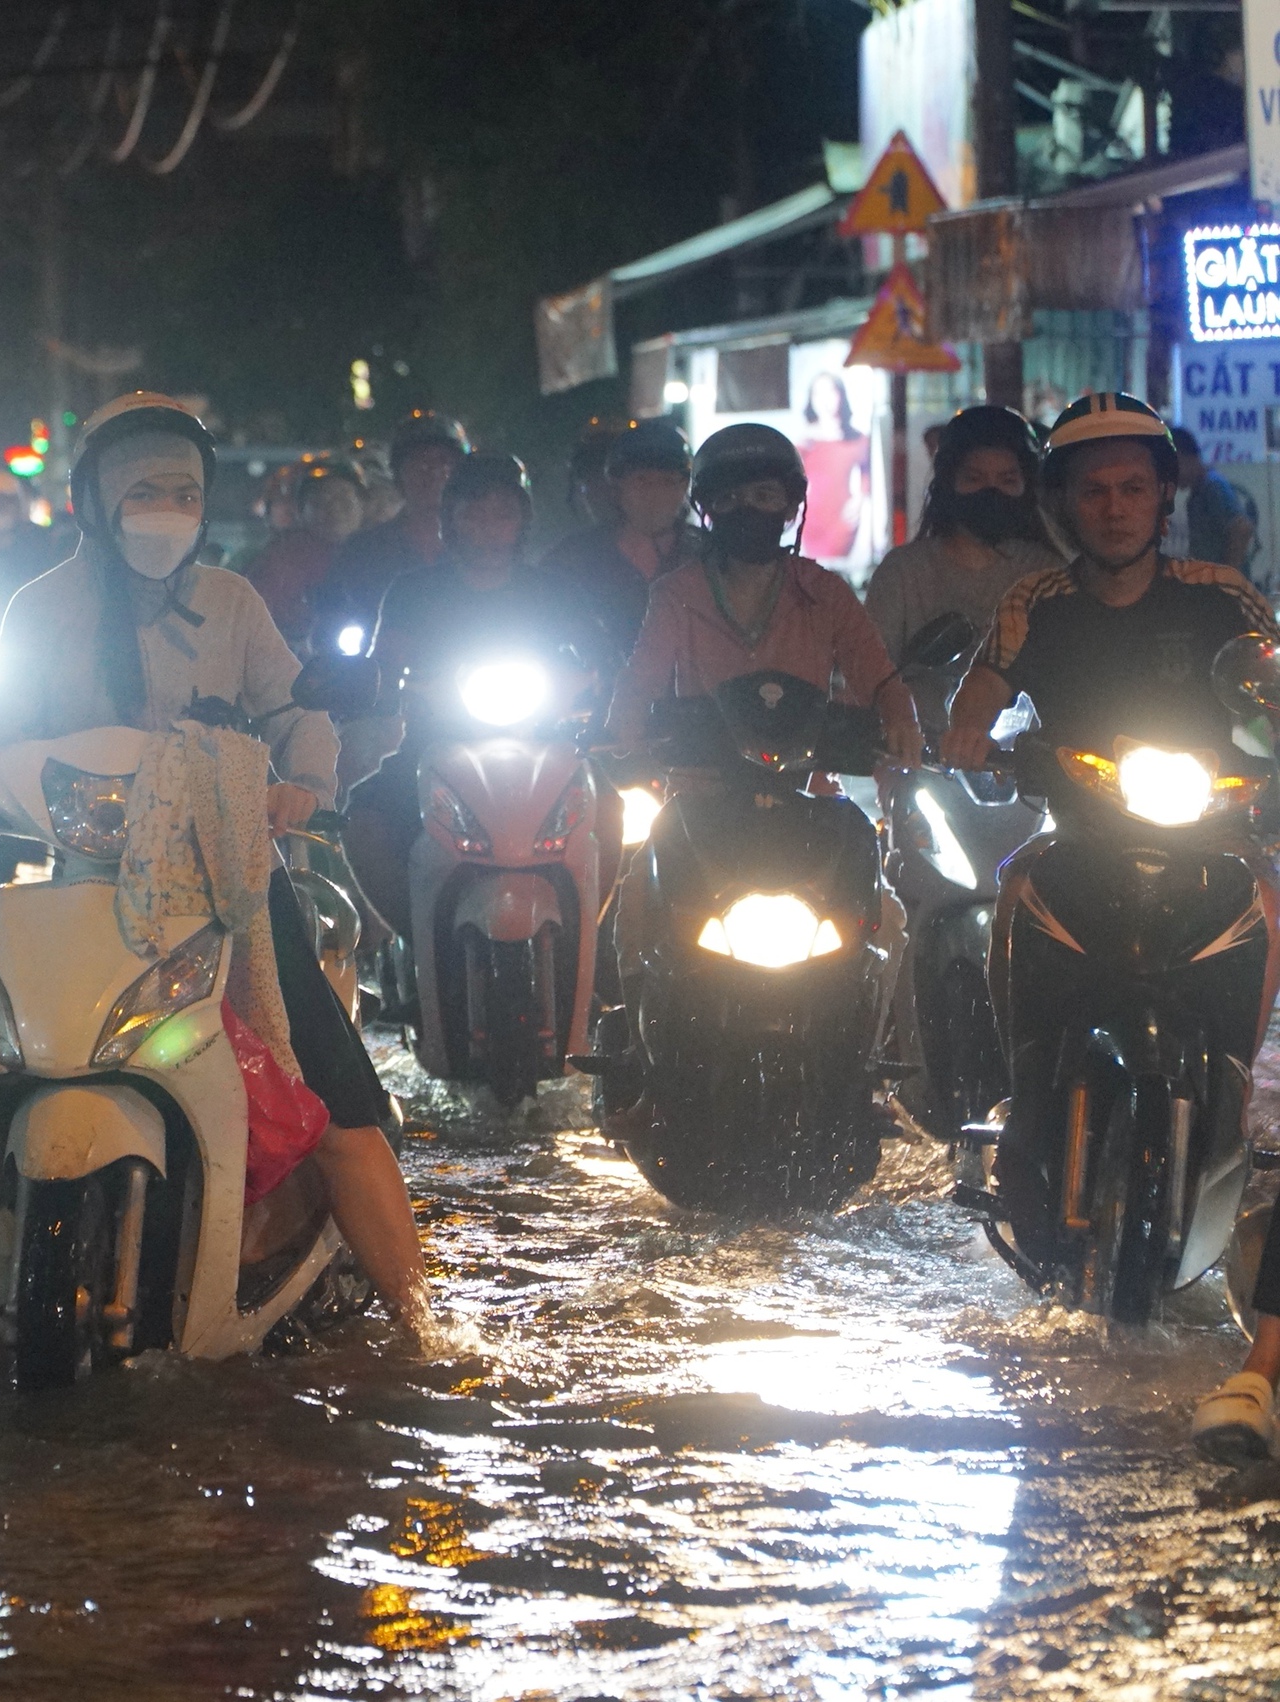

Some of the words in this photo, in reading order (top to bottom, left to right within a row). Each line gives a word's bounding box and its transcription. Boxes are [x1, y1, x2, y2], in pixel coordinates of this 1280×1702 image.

[1259, 88, 1280, 126] V
[1196, 237, 1280, 291] GIẶT
[1183, 352, 1255, 398] CẮT
[1199, 410, 1259, 431] NAM
